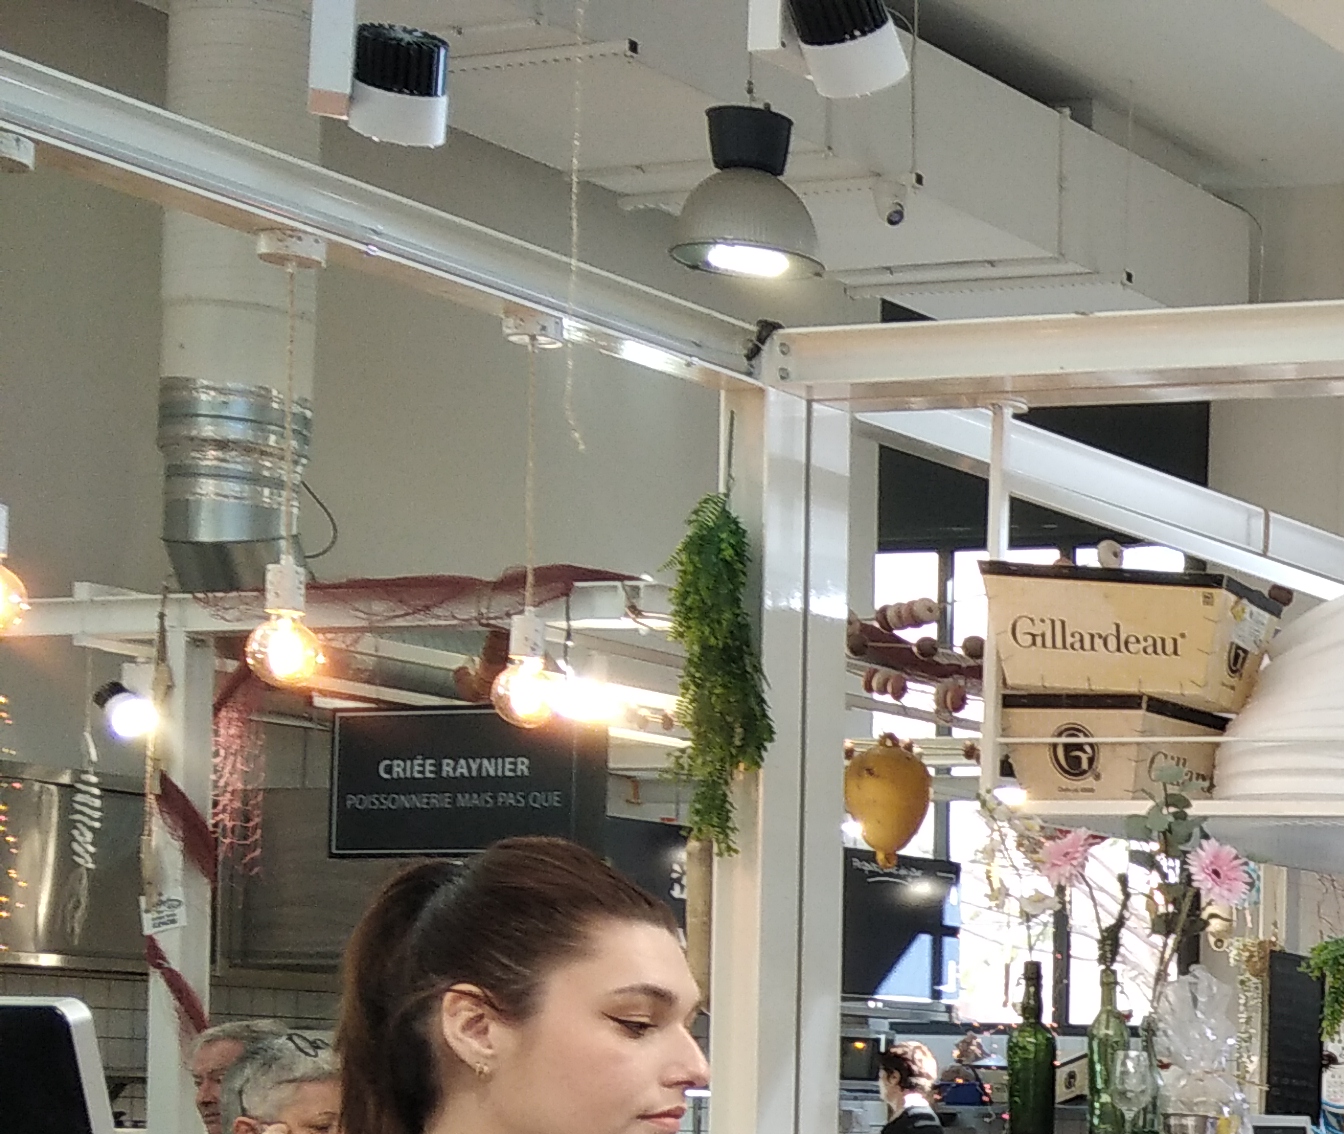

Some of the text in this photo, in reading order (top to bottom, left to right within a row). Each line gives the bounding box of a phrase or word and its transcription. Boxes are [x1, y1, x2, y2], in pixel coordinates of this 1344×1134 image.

[1011, 614, 1182, 658] Gillardeau
[378, 755, 531, 779] CRIÉE RAYNIER
[345, 790, 562, 810] POISSONNERIE MAIS PAS QUE
